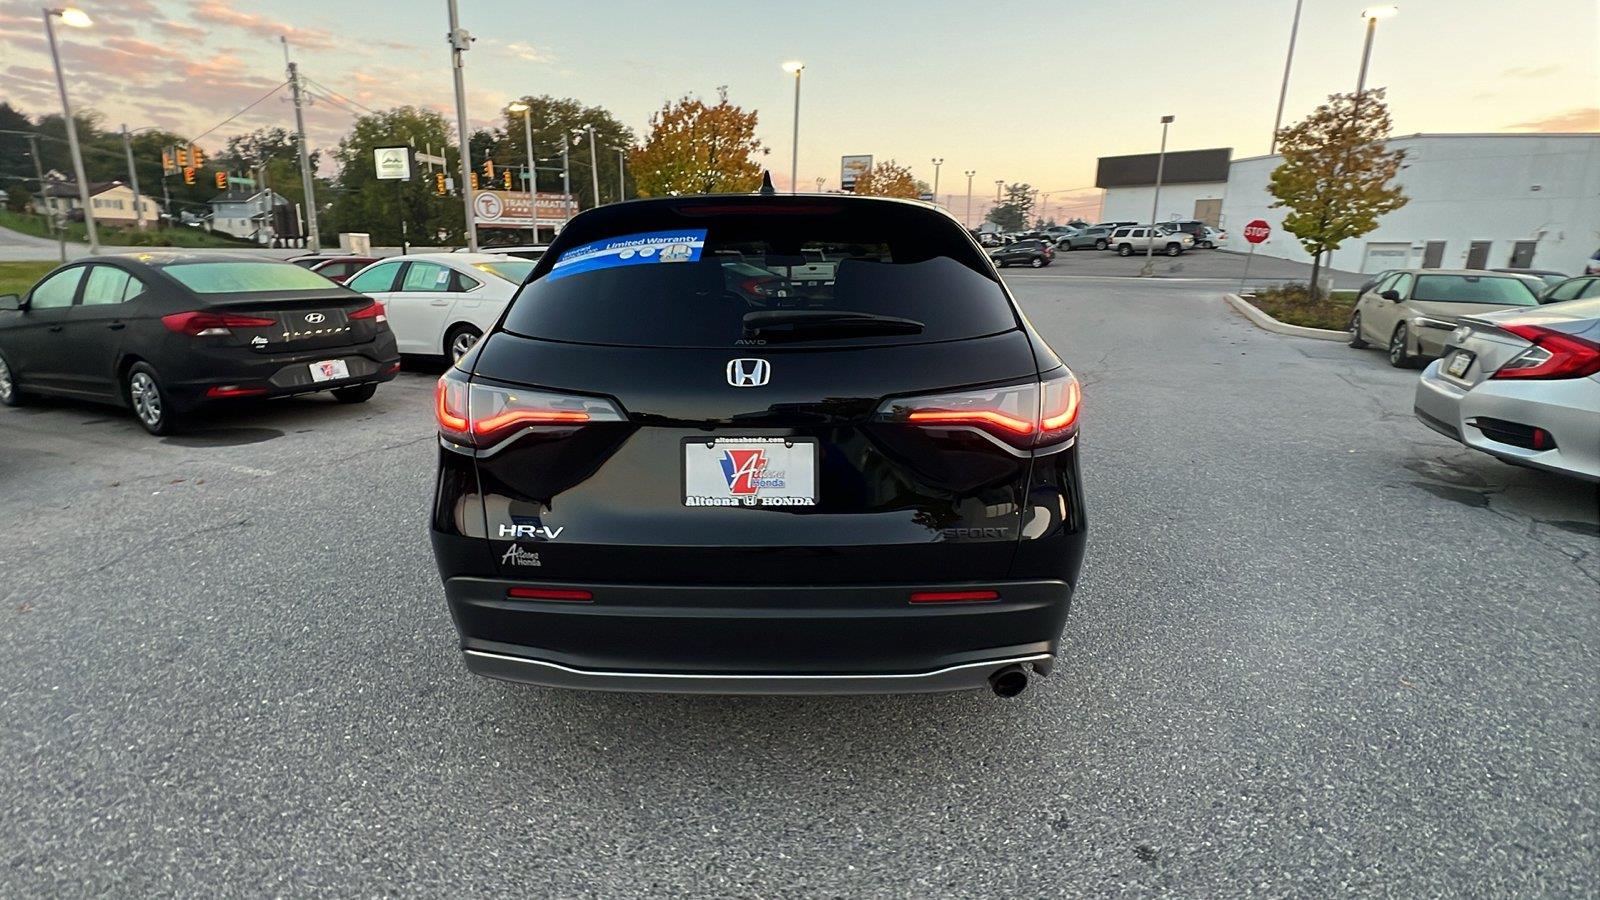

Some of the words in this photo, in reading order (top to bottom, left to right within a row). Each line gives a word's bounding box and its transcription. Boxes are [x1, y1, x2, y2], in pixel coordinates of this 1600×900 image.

[1245, 226, 1269, 237] STOP
[606, 238, 645, 250] Limited
[646, 236, 698, 244] Warranty
[752, 478, 786, 488] Honda
[686, 496, 739, 506] Altoona
[762, 497, 815, 506] HONDA
[498, 524, 564, 538] HR-V
[943, 527, 1009, 539] SPORT
